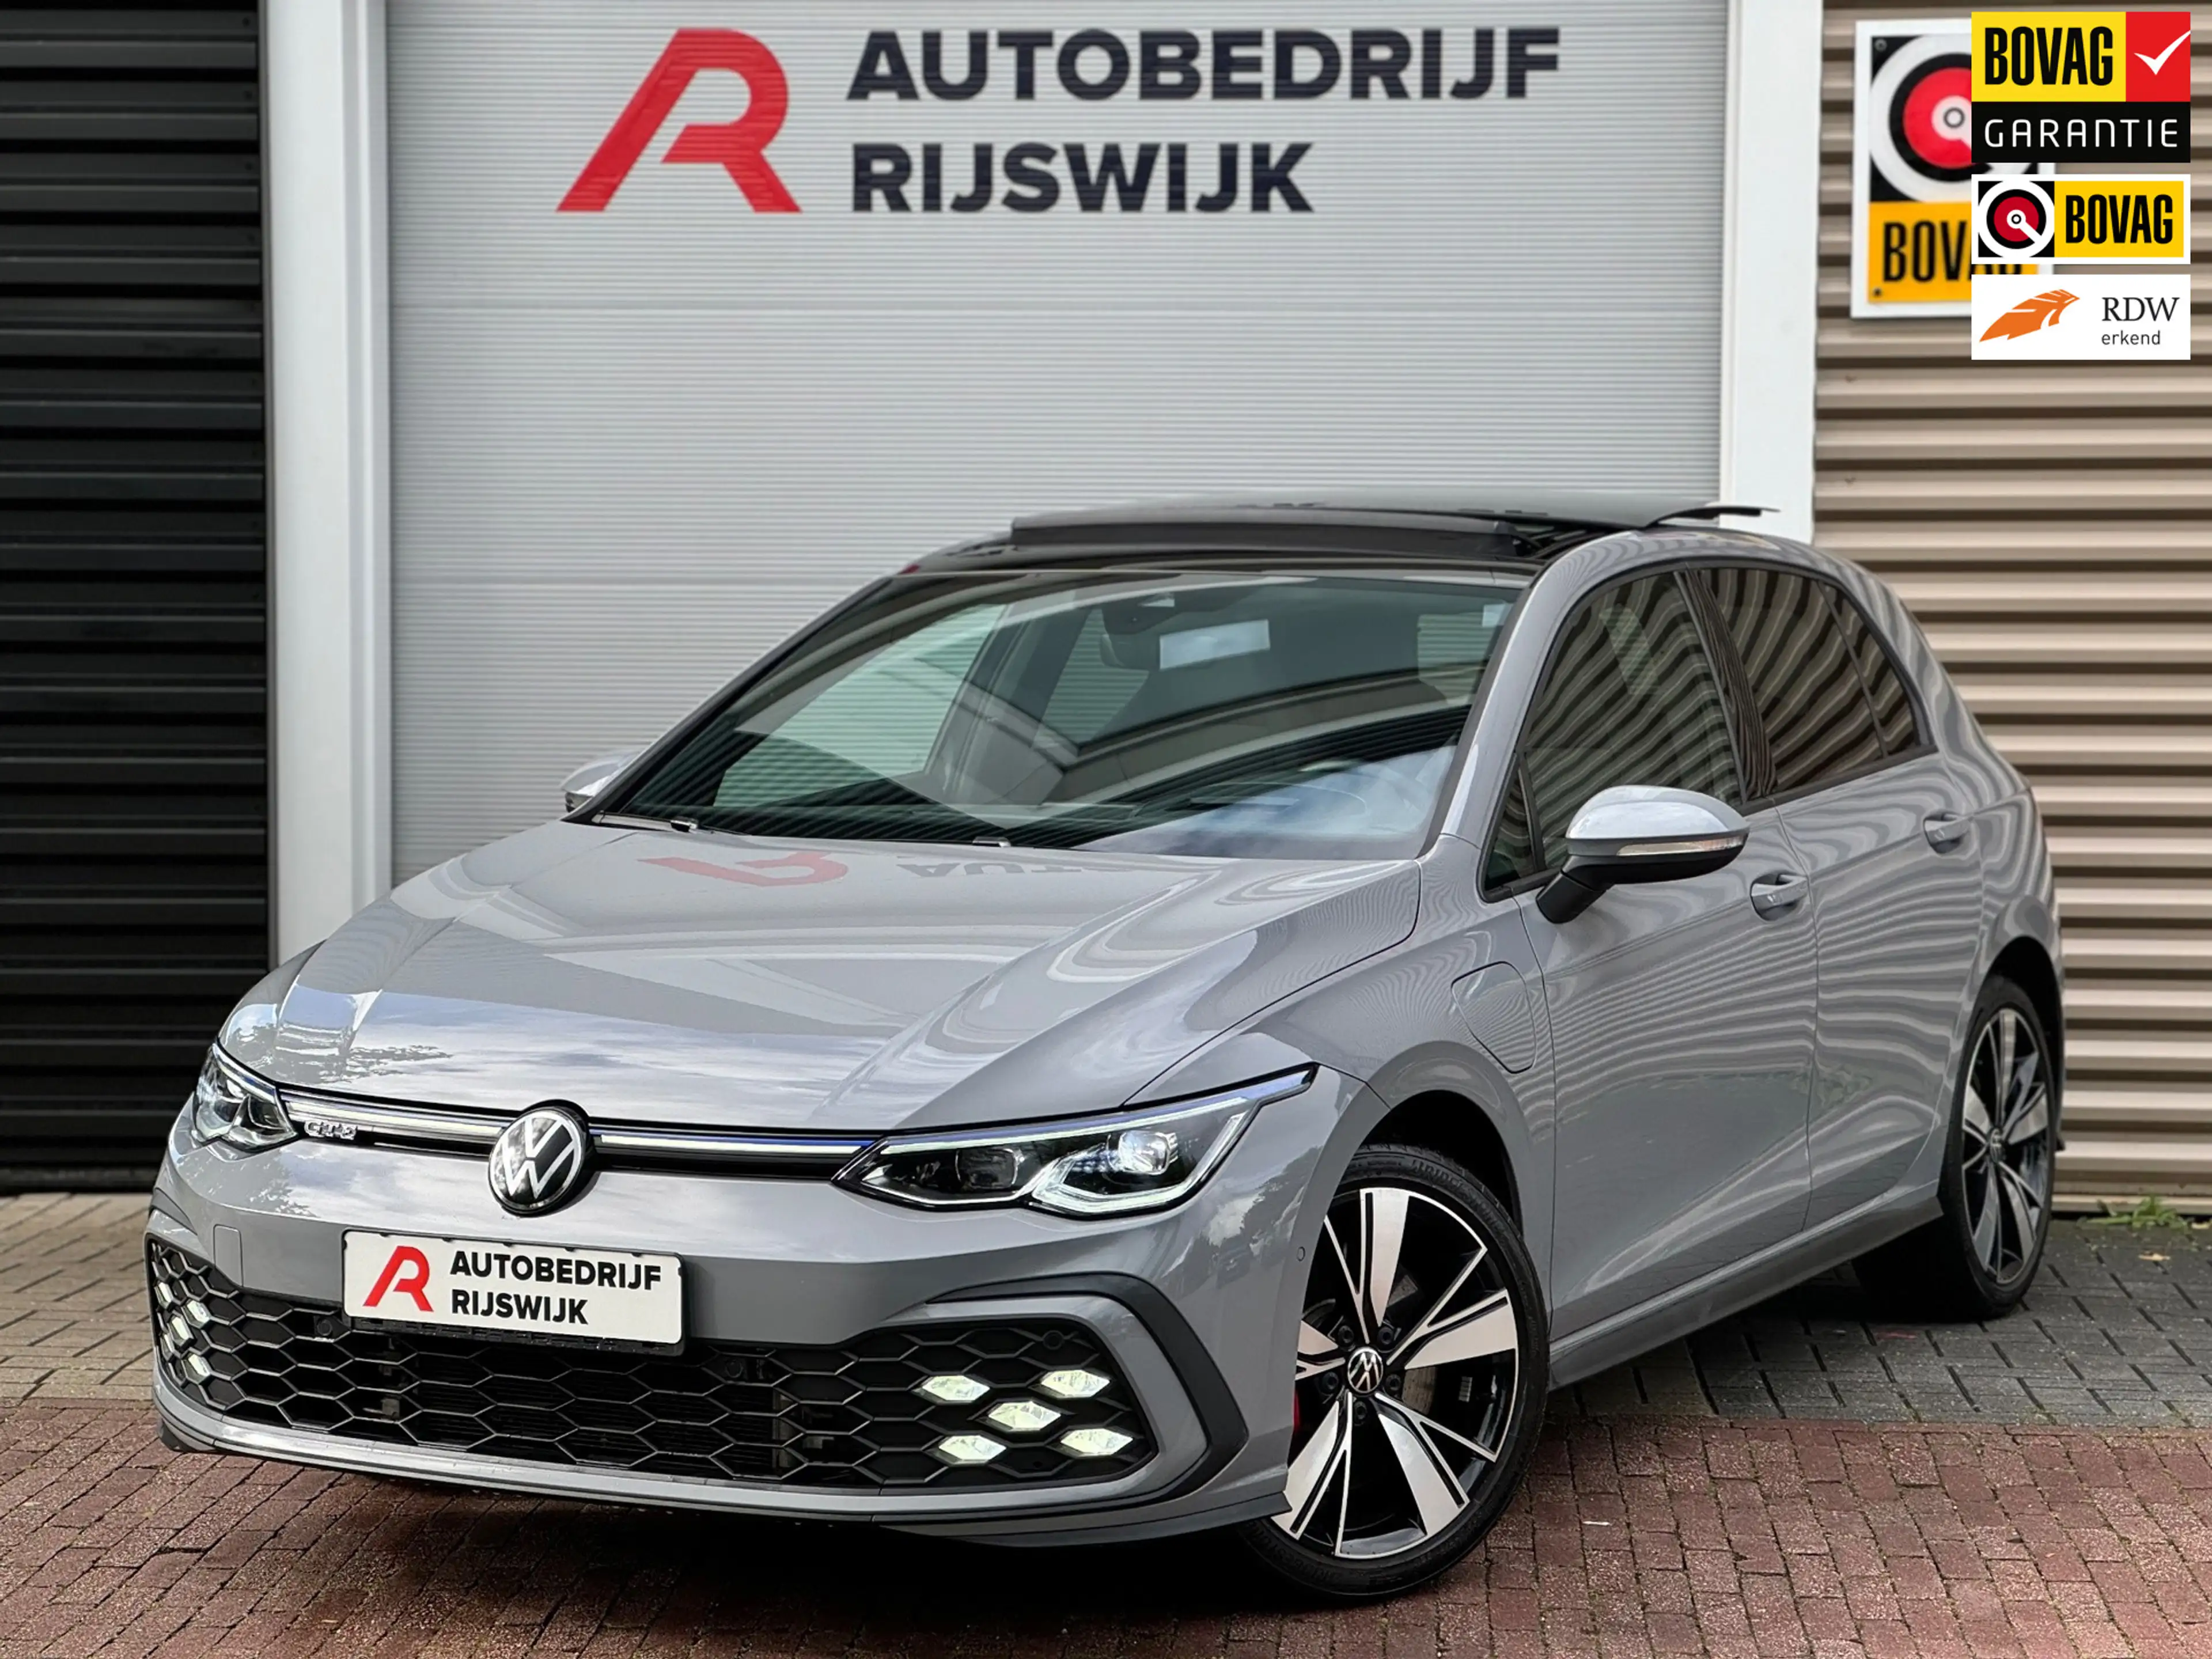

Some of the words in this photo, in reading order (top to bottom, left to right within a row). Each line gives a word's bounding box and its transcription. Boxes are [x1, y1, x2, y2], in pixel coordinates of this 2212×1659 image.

[849, 29, 1559, 100] AUTOBEDRIJF
[854, 143, 1312, 212] RIJSWIJK
[450, 1251, 661, 1290] AUTOBEDRIJF
[452, 1289, 588, 1325] RIJSWIJK
